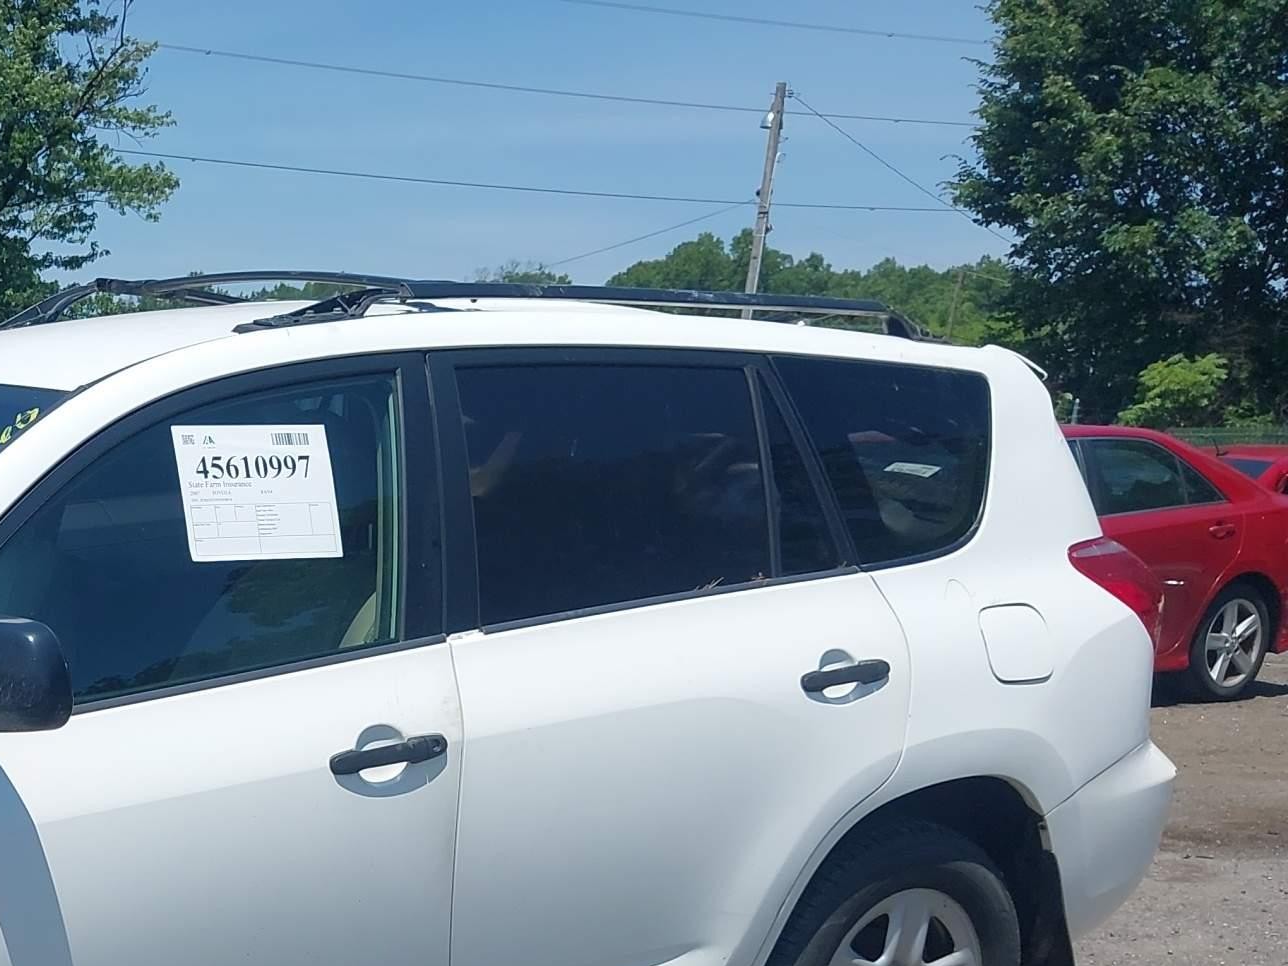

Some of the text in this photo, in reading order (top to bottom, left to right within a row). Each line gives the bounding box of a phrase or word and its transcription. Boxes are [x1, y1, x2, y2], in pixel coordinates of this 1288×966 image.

[196, 455, 310, 479] 45610997
[188, 481, 204, 489] State
[205, 481, 222, 489] Farm
